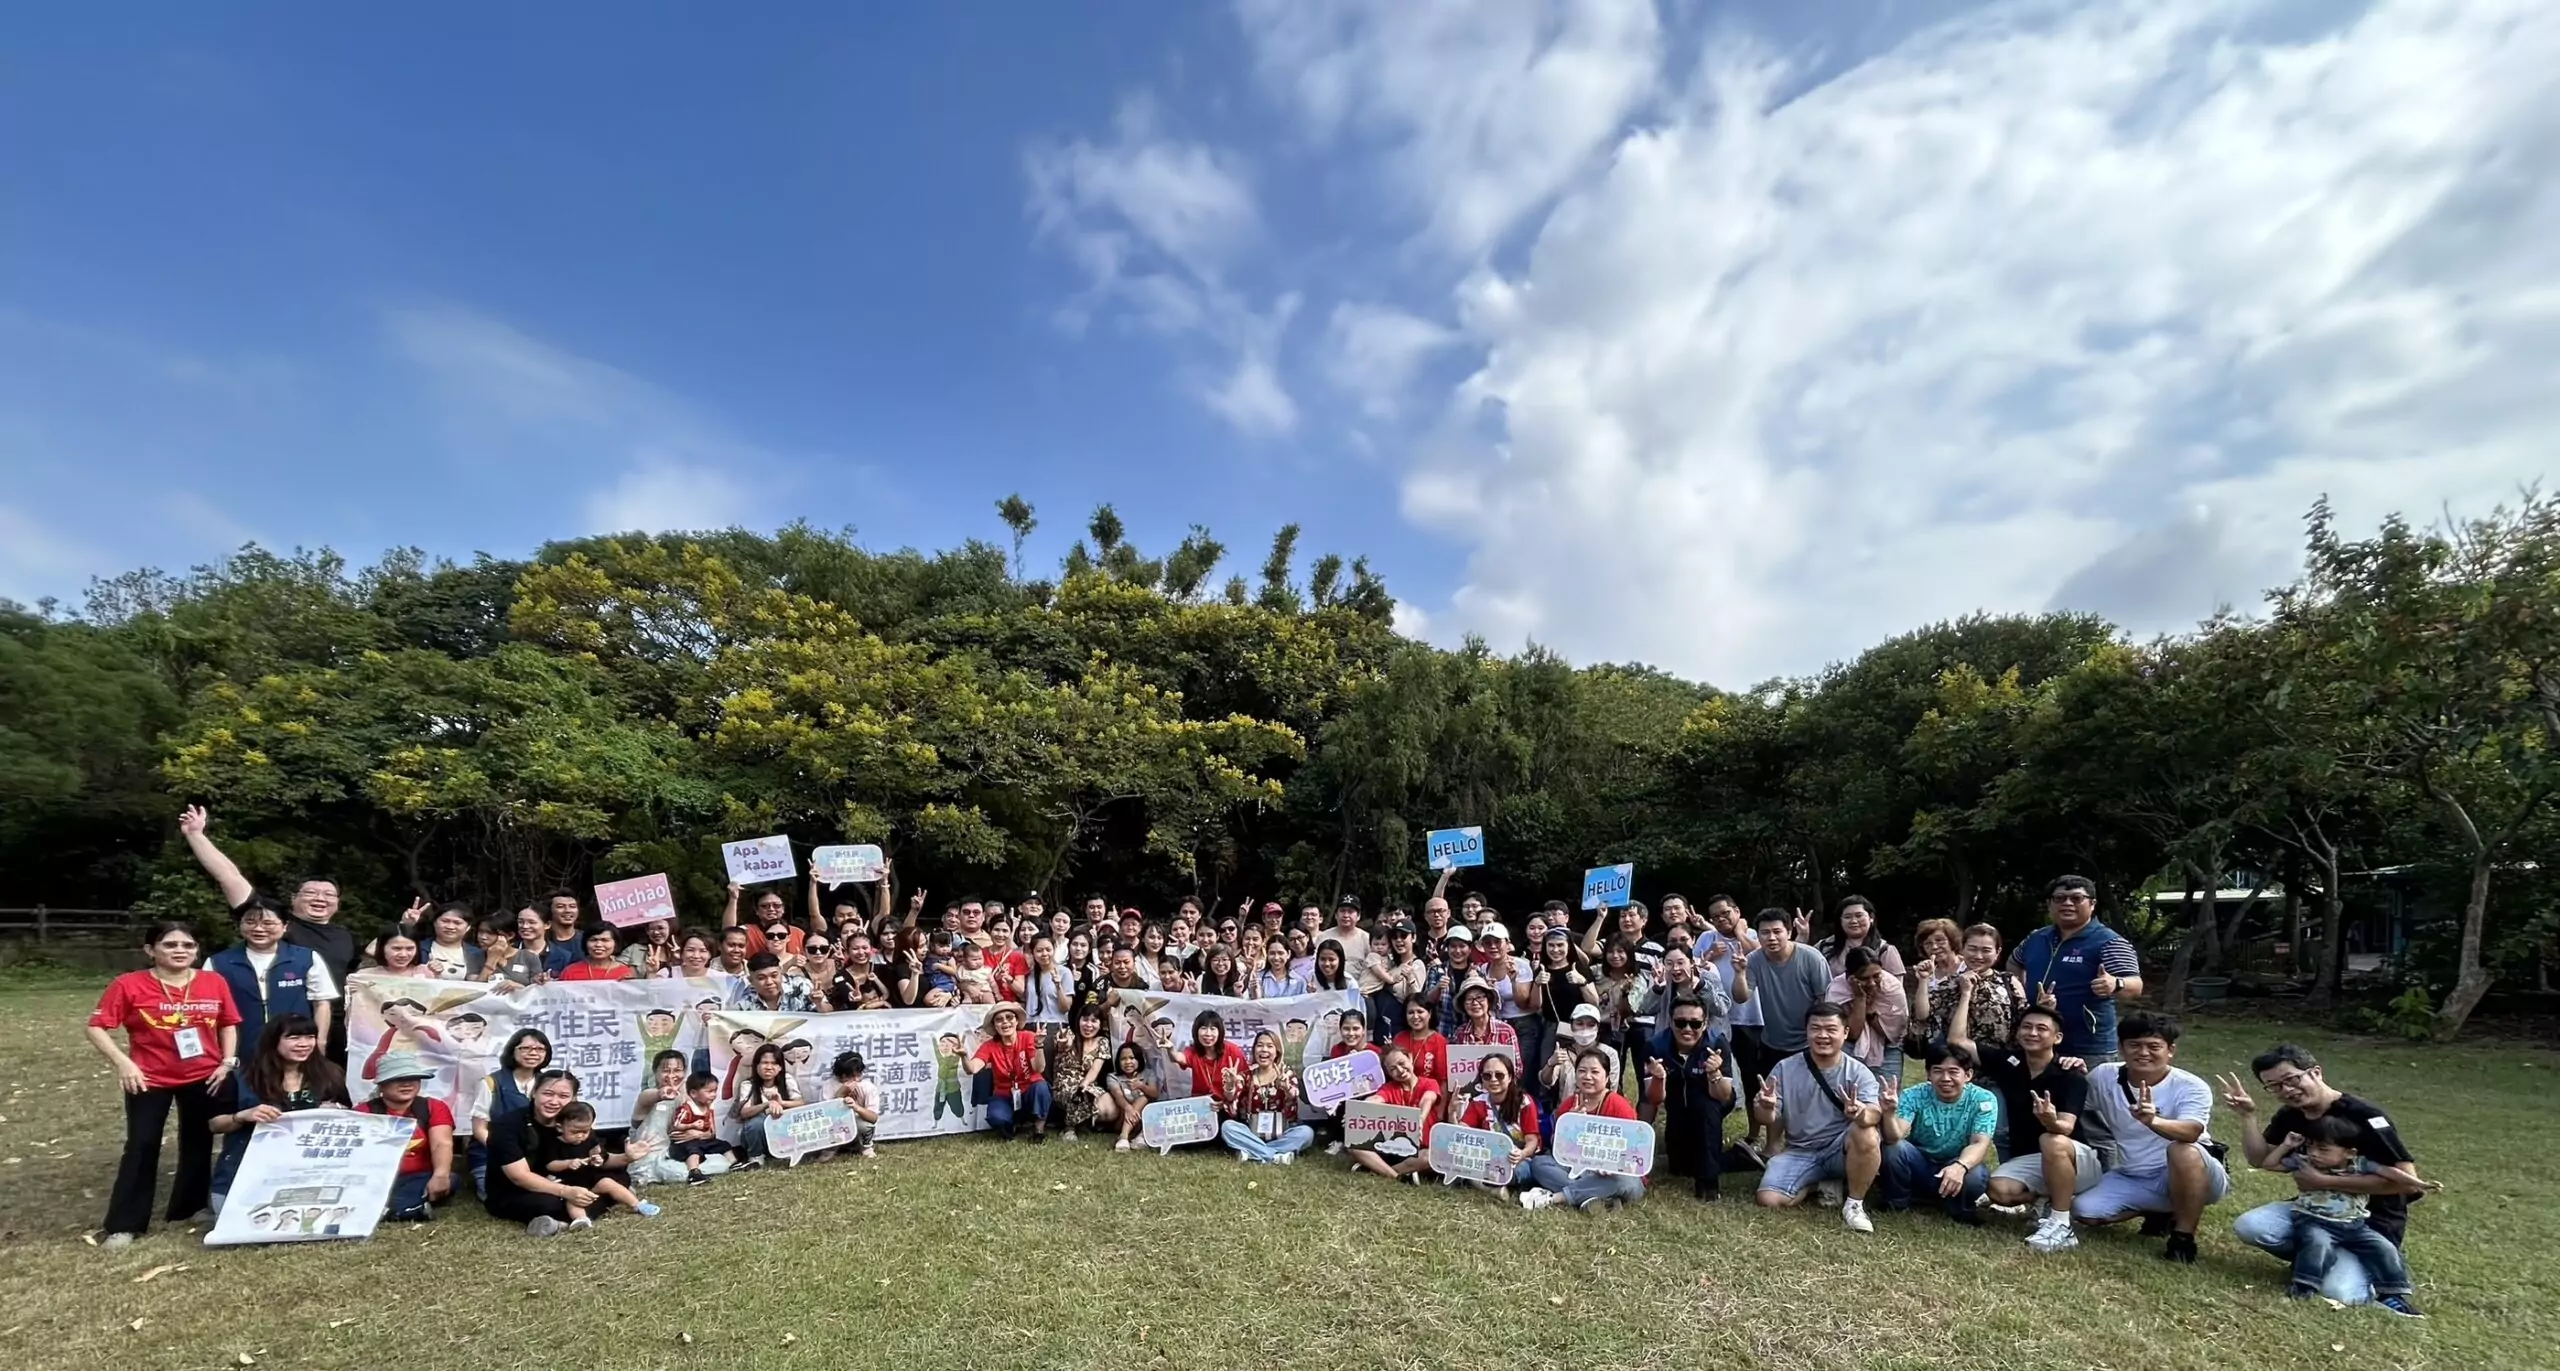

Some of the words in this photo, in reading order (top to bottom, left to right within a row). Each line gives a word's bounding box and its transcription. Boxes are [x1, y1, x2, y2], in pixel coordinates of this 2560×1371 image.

[733, 846, 759, 858] Apa
[1433, 838, 1477, 857] HELLO
[744, 859, 784, 871] kabar
[1588, 876, 1626, 897] HELLO
[601, 896, 626, 914] Xin
[834, 1033, 919, 1060] 新住民
[1309, 1060, 1354, 1092] 你好
[311, 1122, 361, 1136] 新住民
[1348, 1115, 1417, 1133] สวัสดีครับ
[1587, 1122, 1621, 1137] 新住民
[1455, 1133, 1485, 1148] 新住民
